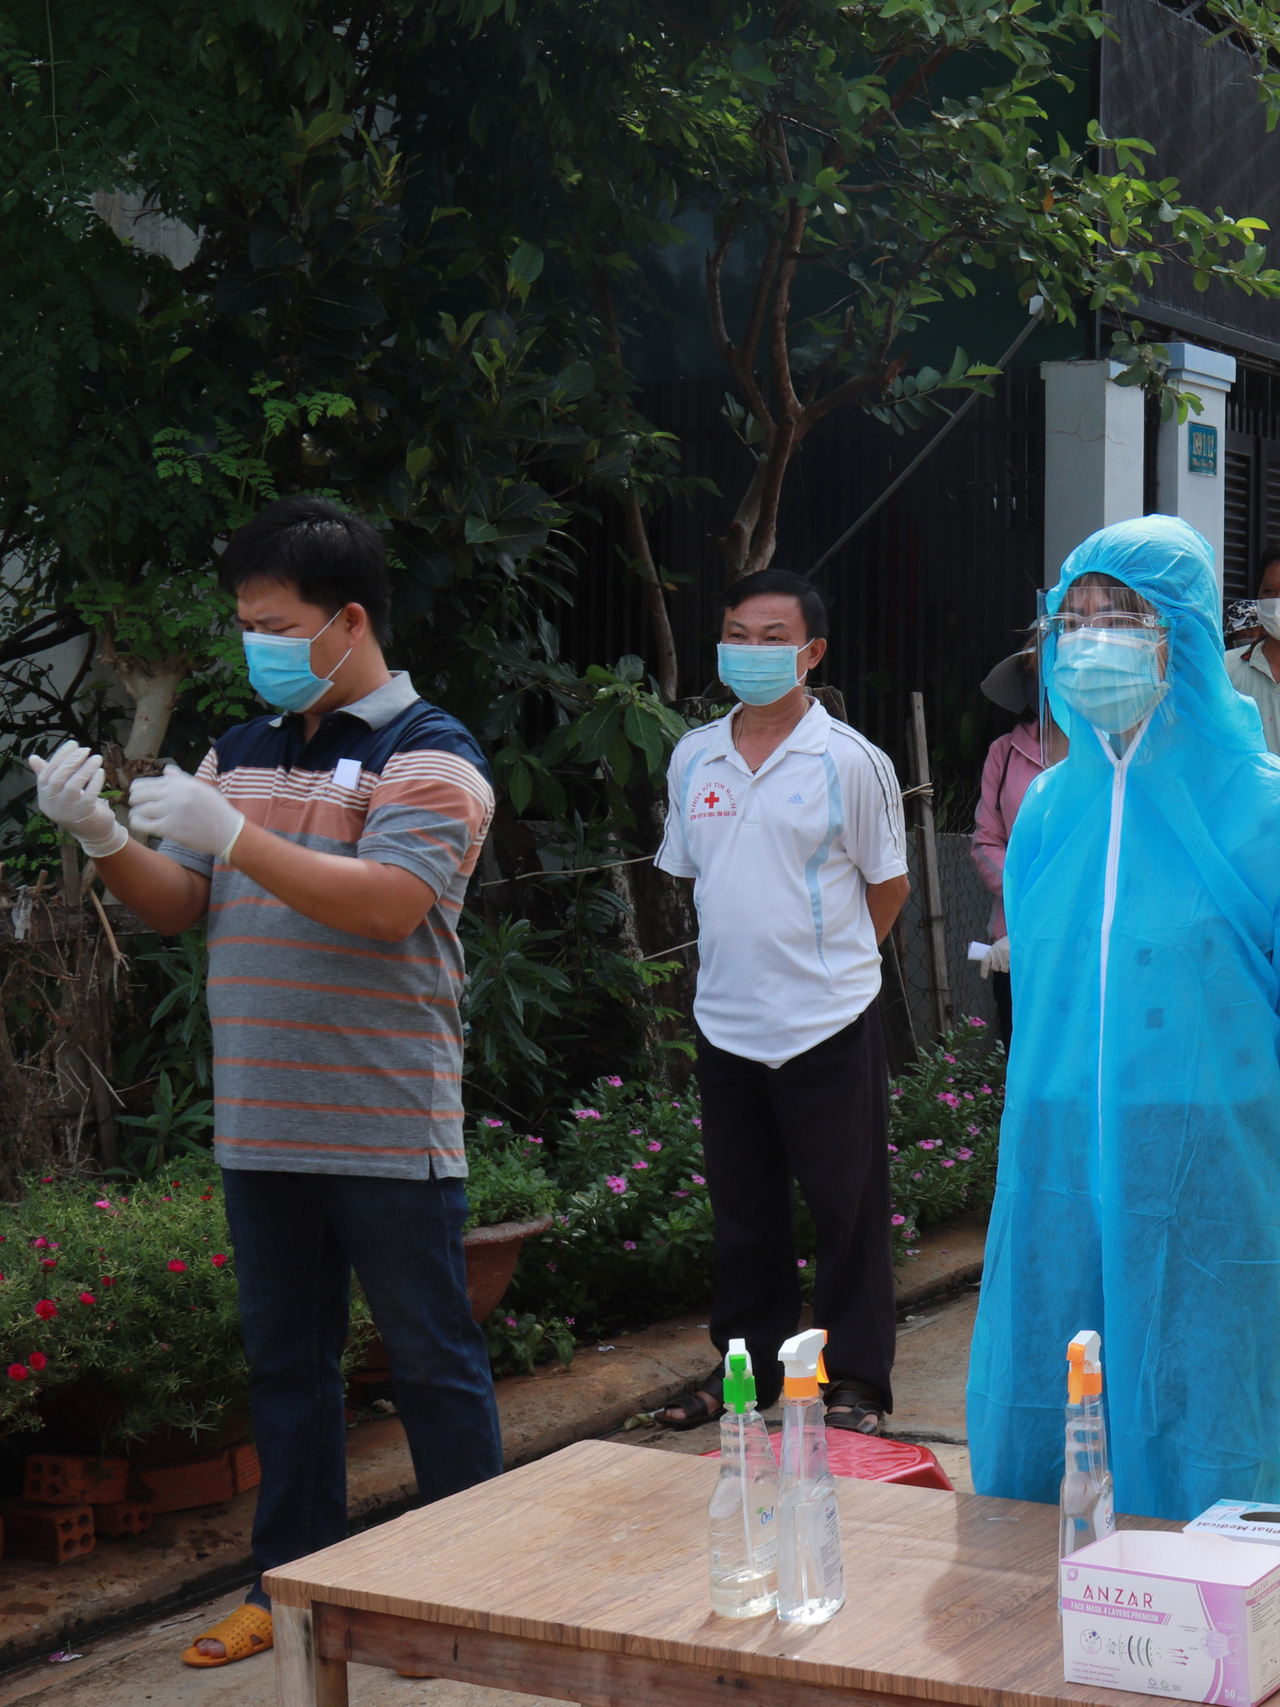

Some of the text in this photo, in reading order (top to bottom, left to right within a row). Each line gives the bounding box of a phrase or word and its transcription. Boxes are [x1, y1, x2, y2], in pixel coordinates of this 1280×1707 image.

[1196, 1521, 1248, 1532] Medical
[1083, 1584, 1153, 1609] ANZAR
[1070, 1601, 1159, 1622] FACE MASK 4 LAYERS PREMIUM
[1224, 1689, 1236, 1698] 50
